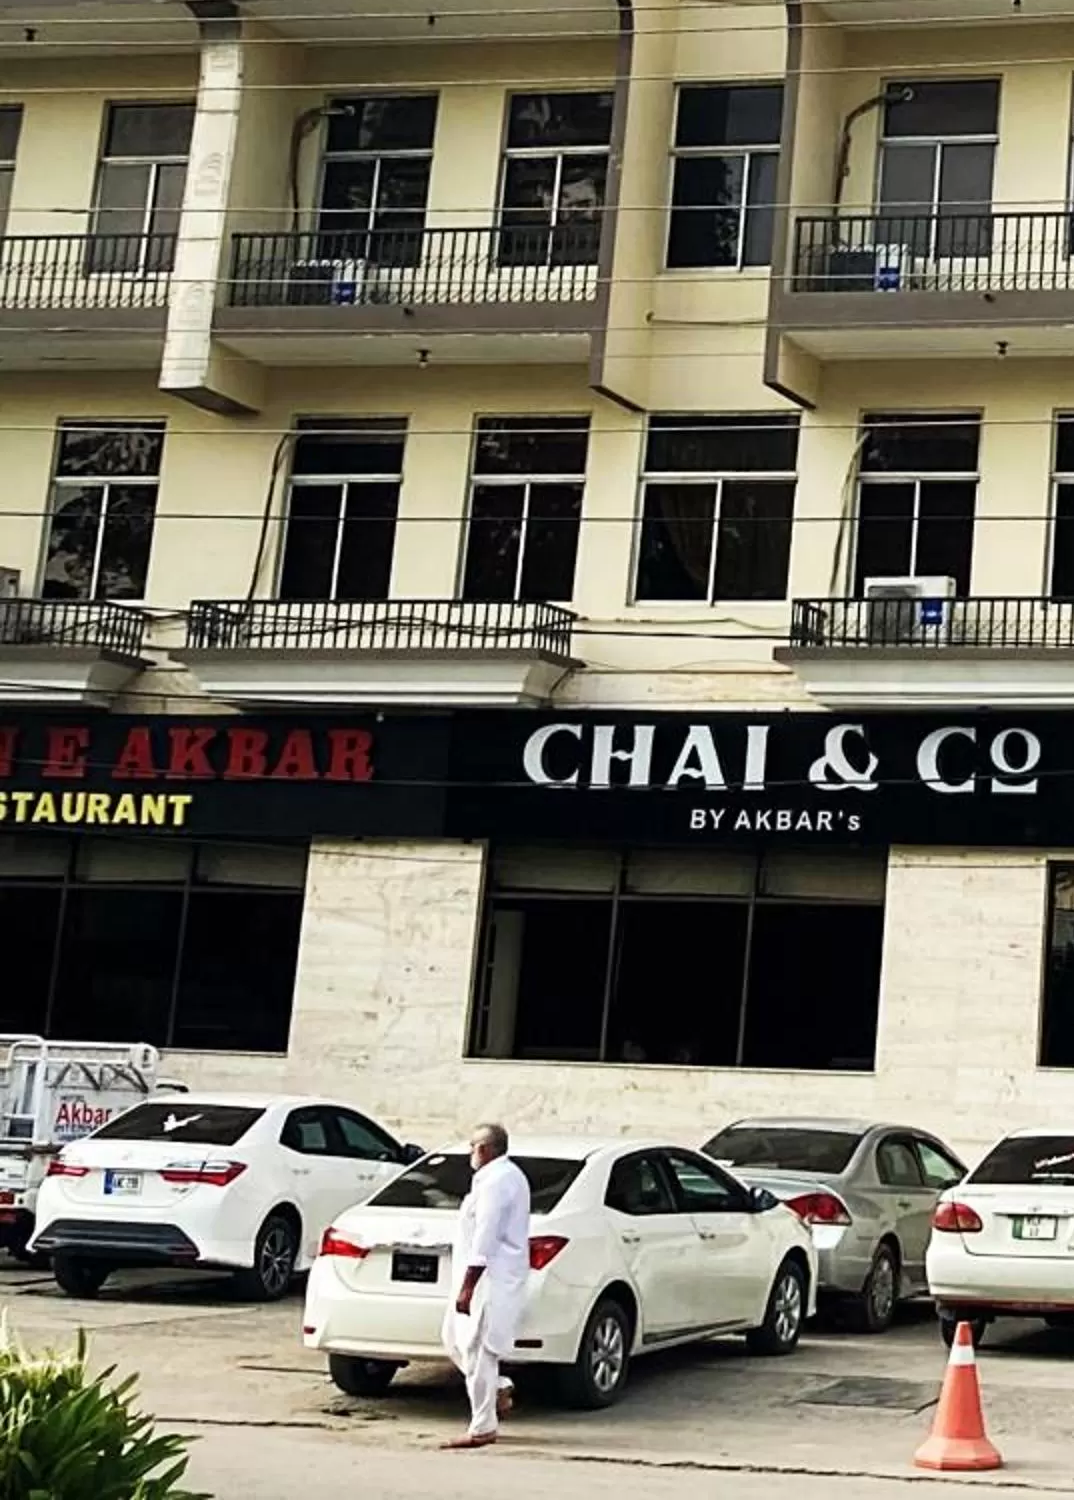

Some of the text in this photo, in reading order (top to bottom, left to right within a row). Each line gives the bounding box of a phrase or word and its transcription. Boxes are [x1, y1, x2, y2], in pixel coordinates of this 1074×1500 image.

[111, 727, 375, 781] AKBAR
[523, 723, 771, 790] CHAI
[808, 724, 879, 790] &
[690, 809, 861, 831] BY AKBAR's
[55, 1102, 113, 1125] Akbar
